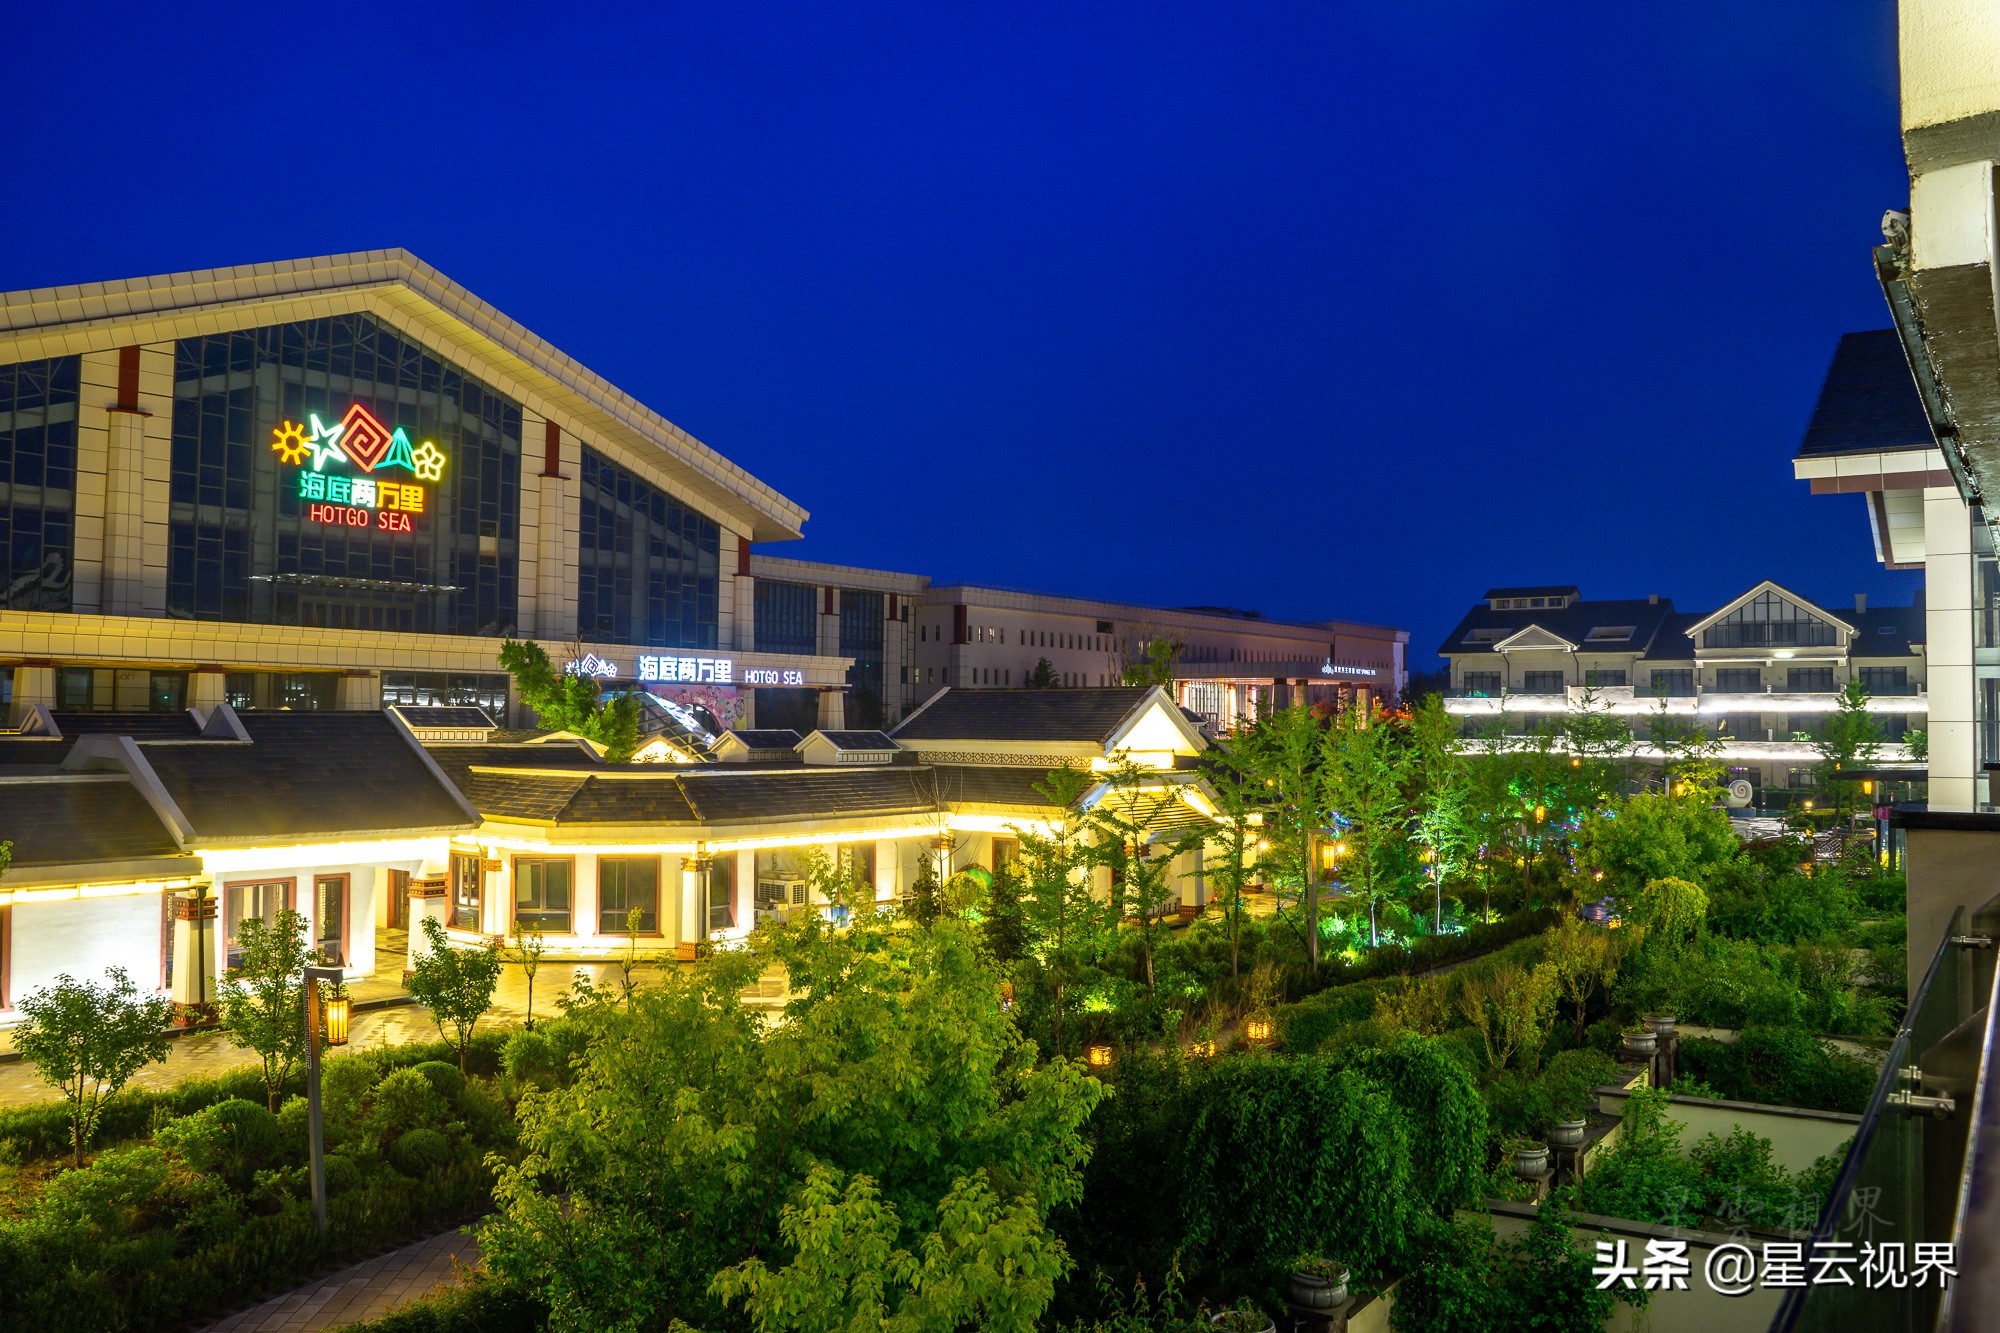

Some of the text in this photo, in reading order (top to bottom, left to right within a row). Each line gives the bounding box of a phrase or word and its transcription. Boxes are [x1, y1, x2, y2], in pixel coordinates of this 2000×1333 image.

[299, 470, 423, 512] 海底两万里
[311, 504, 411, 532] HOTGO SEA
[639, 656, 732, 683] 海底两万里
[745, 669, 803, 685] HOTGO SEA
